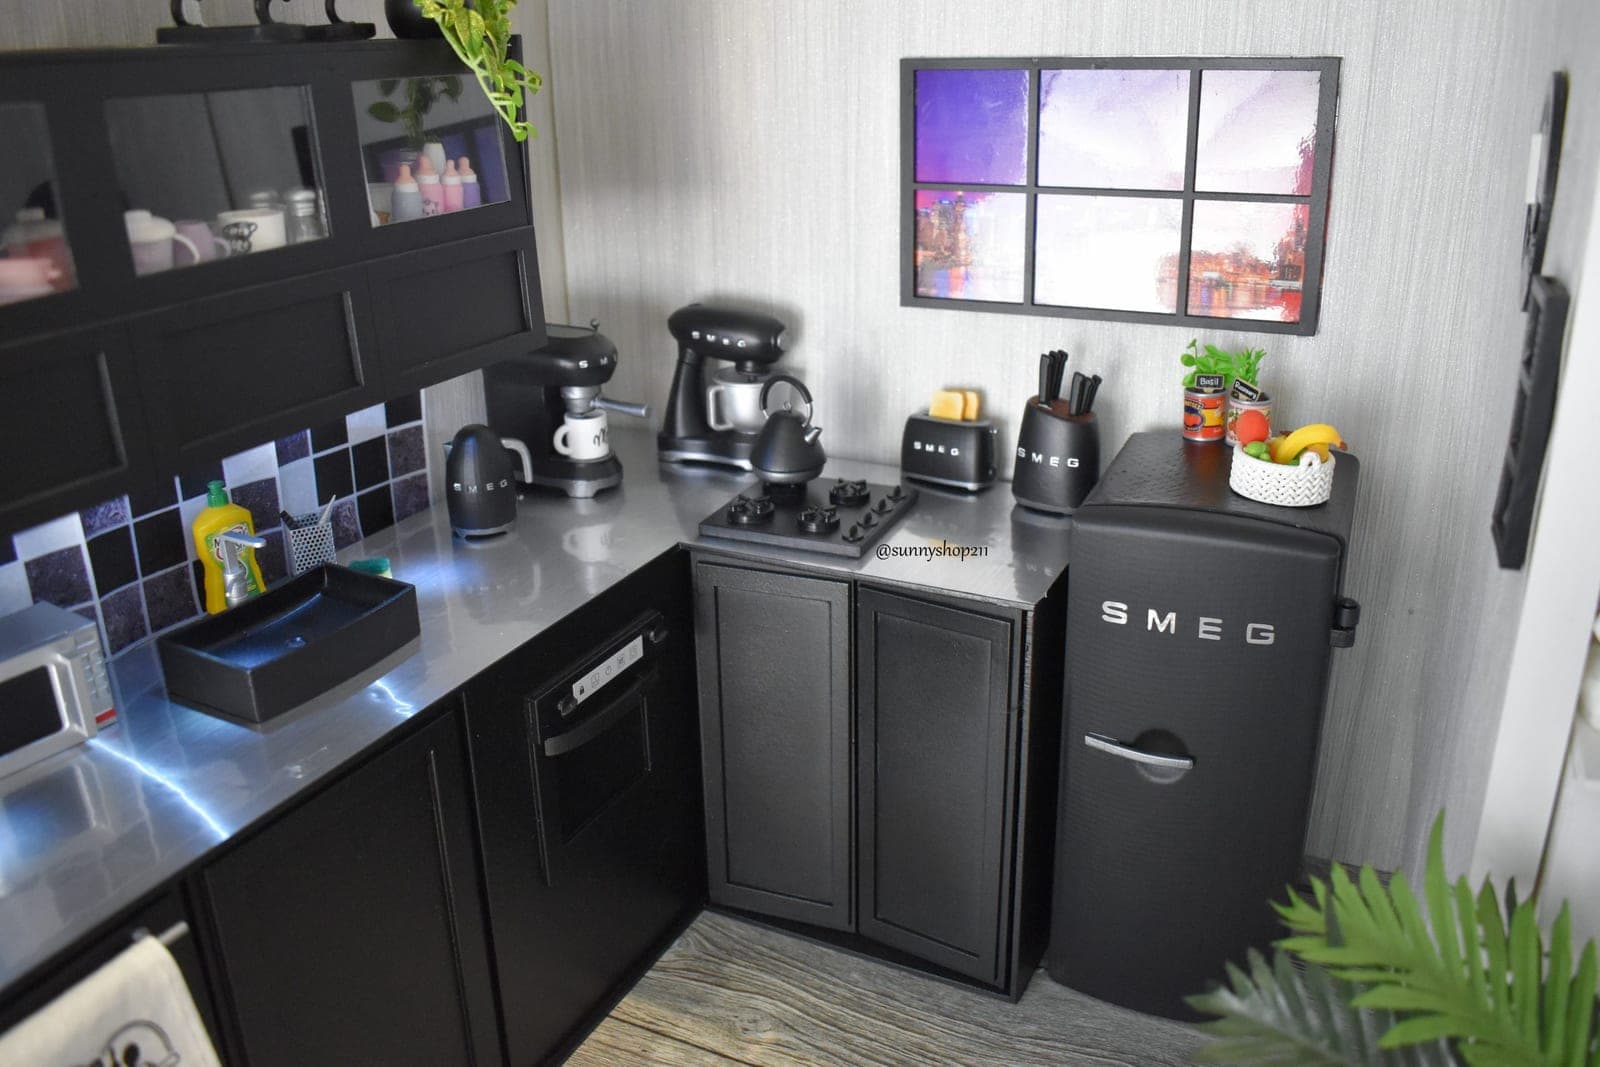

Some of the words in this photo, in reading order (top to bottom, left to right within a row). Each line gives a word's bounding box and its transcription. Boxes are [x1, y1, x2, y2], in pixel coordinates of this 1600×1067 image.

[1200, 378, 1219, 386] Basil
[913, 441, 959, 456] SMEG
[1017, 446, 1080, 468] SMEG
[1101, 600, 1275, 645] SMEG
